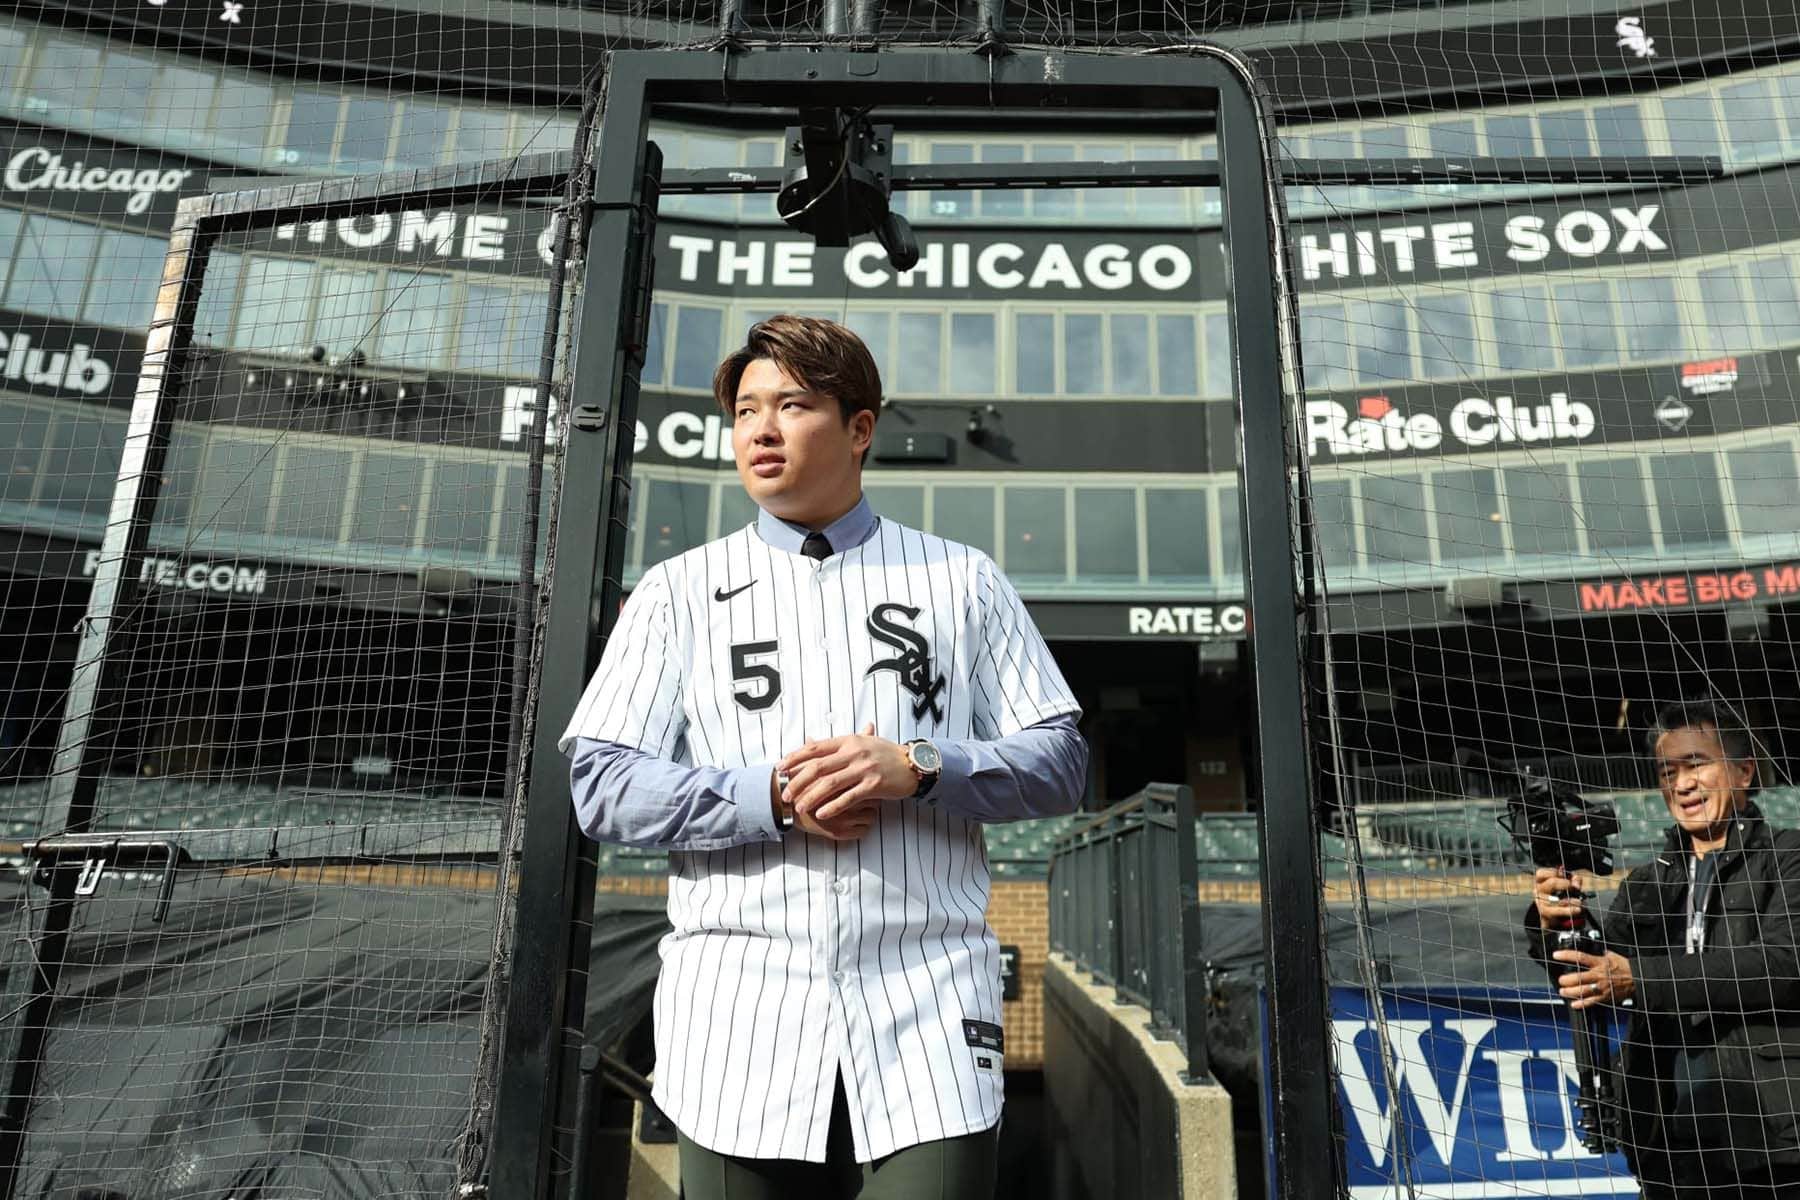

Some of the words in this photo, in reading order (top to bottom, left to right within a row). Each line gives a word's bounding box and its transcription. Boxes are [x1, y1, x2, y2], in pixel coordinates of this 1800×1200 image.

[4, 146, 192, 215] Chicago
[668, 235, 816, 287] THE
[843, 242, 1193, 290] CHICAGO
[1296, 221, 1479, 281] HITE
[1503, 204, 1668, 263] SOX
[1303, 398, 1443, 457] Rate
[1450, 392, 1596, 447] Club
[82, 550, 268, 594] RTE.COM
[1579, 577, 1690, 612] MAKE
[1694, 571, 1758, 602] BIG
[1763, 565, 1800, 596] M
[729, 639, 784, 714] 5
